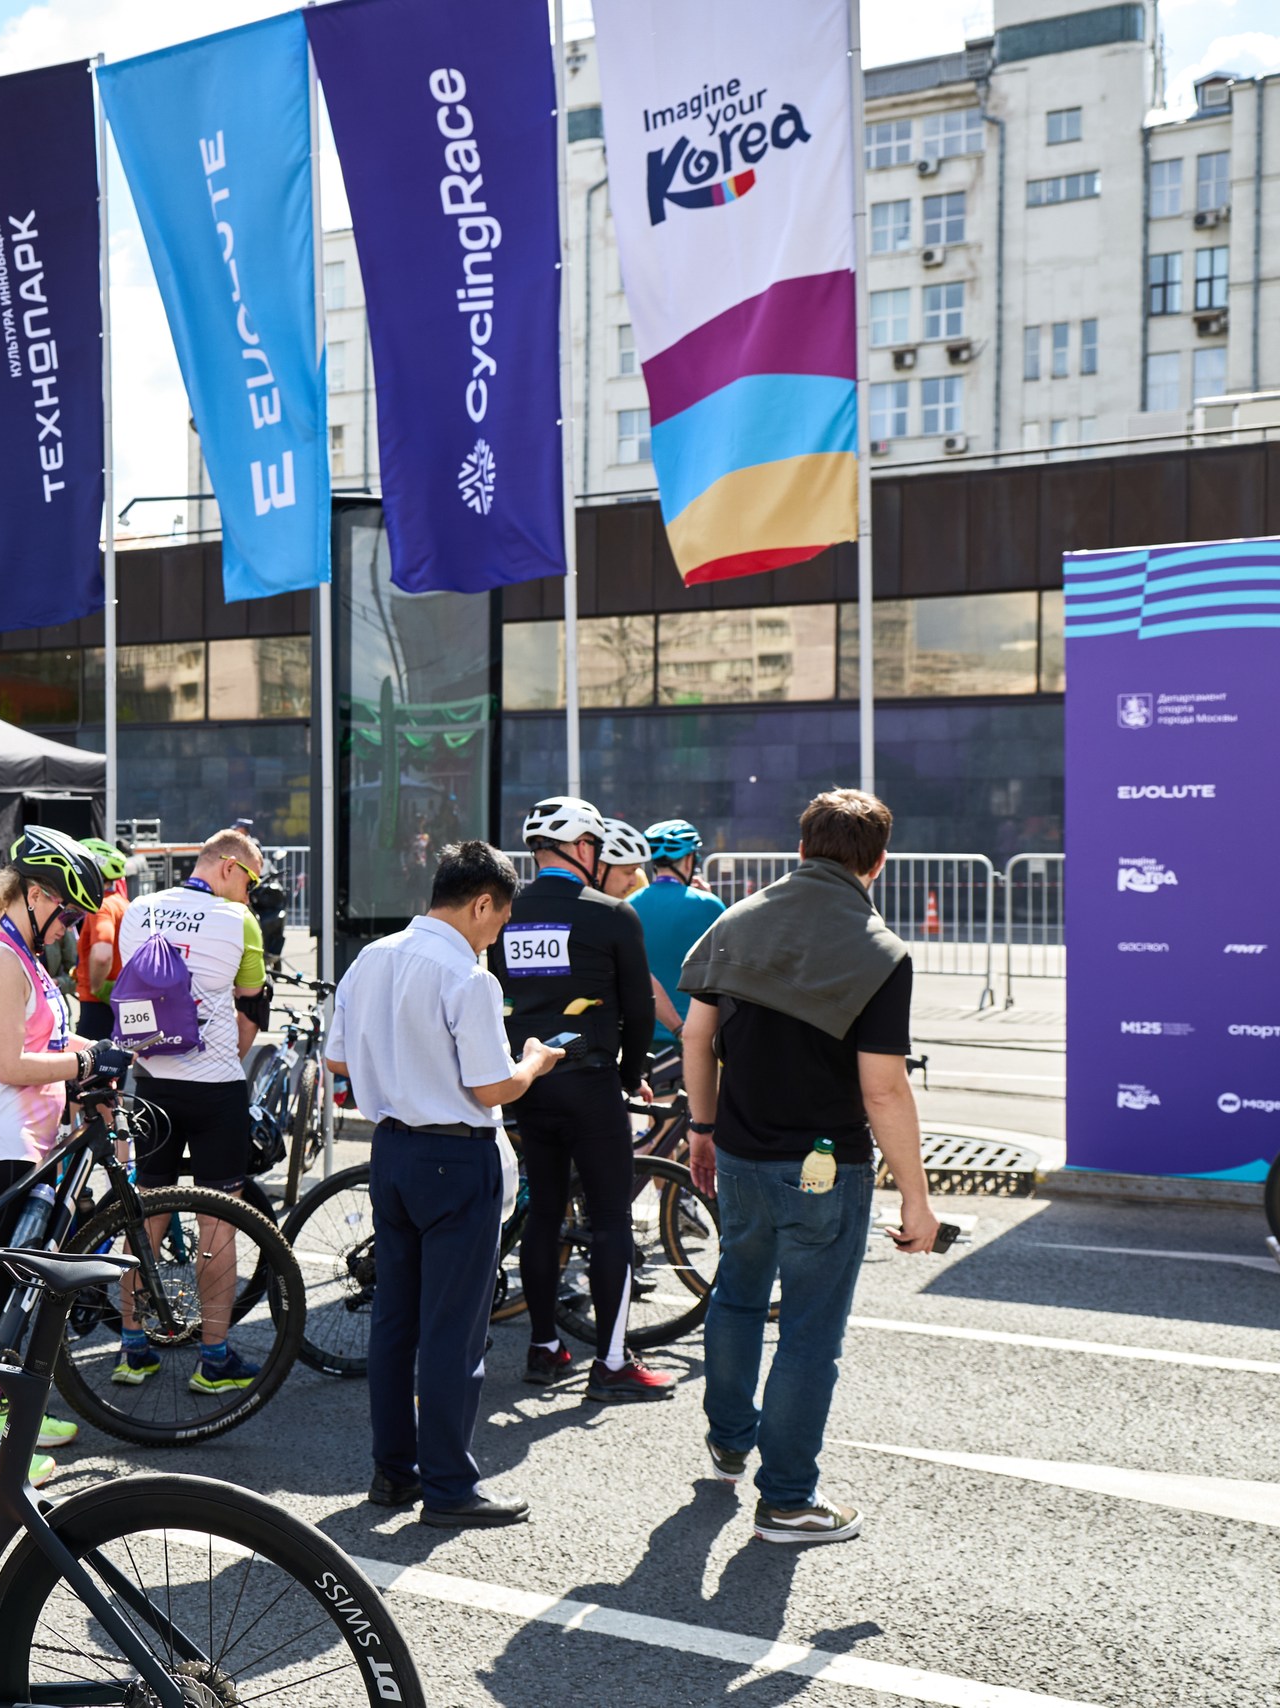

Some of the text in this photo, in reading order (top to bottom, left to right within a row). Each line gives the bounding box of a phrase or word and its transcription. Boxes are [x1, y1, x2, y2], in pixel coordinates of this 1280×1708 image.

[644, 78, 741, 133] Imagine
[706, 88, 768, 137] your
[647, 103, 812, 227] Korea
[429, 67, 503, 424] CyclingRace
[1, 308, 22, 378] КУЛЬТУРА
[8, 209, 65, 503] ТЕХНОПАРК
[1117, 784, 1216, 799] EVOLUTE
[141, 919, 200, 933] АНТОН
[510, 939, 560, 960] 3540
[123, 1012, 150, 1025] 2306
[282, 1298, 289, 1311] DT
[175, 1393, 260, 1439] SCHWALBE
[314, 1572, 402, 1702] DT SWISS
